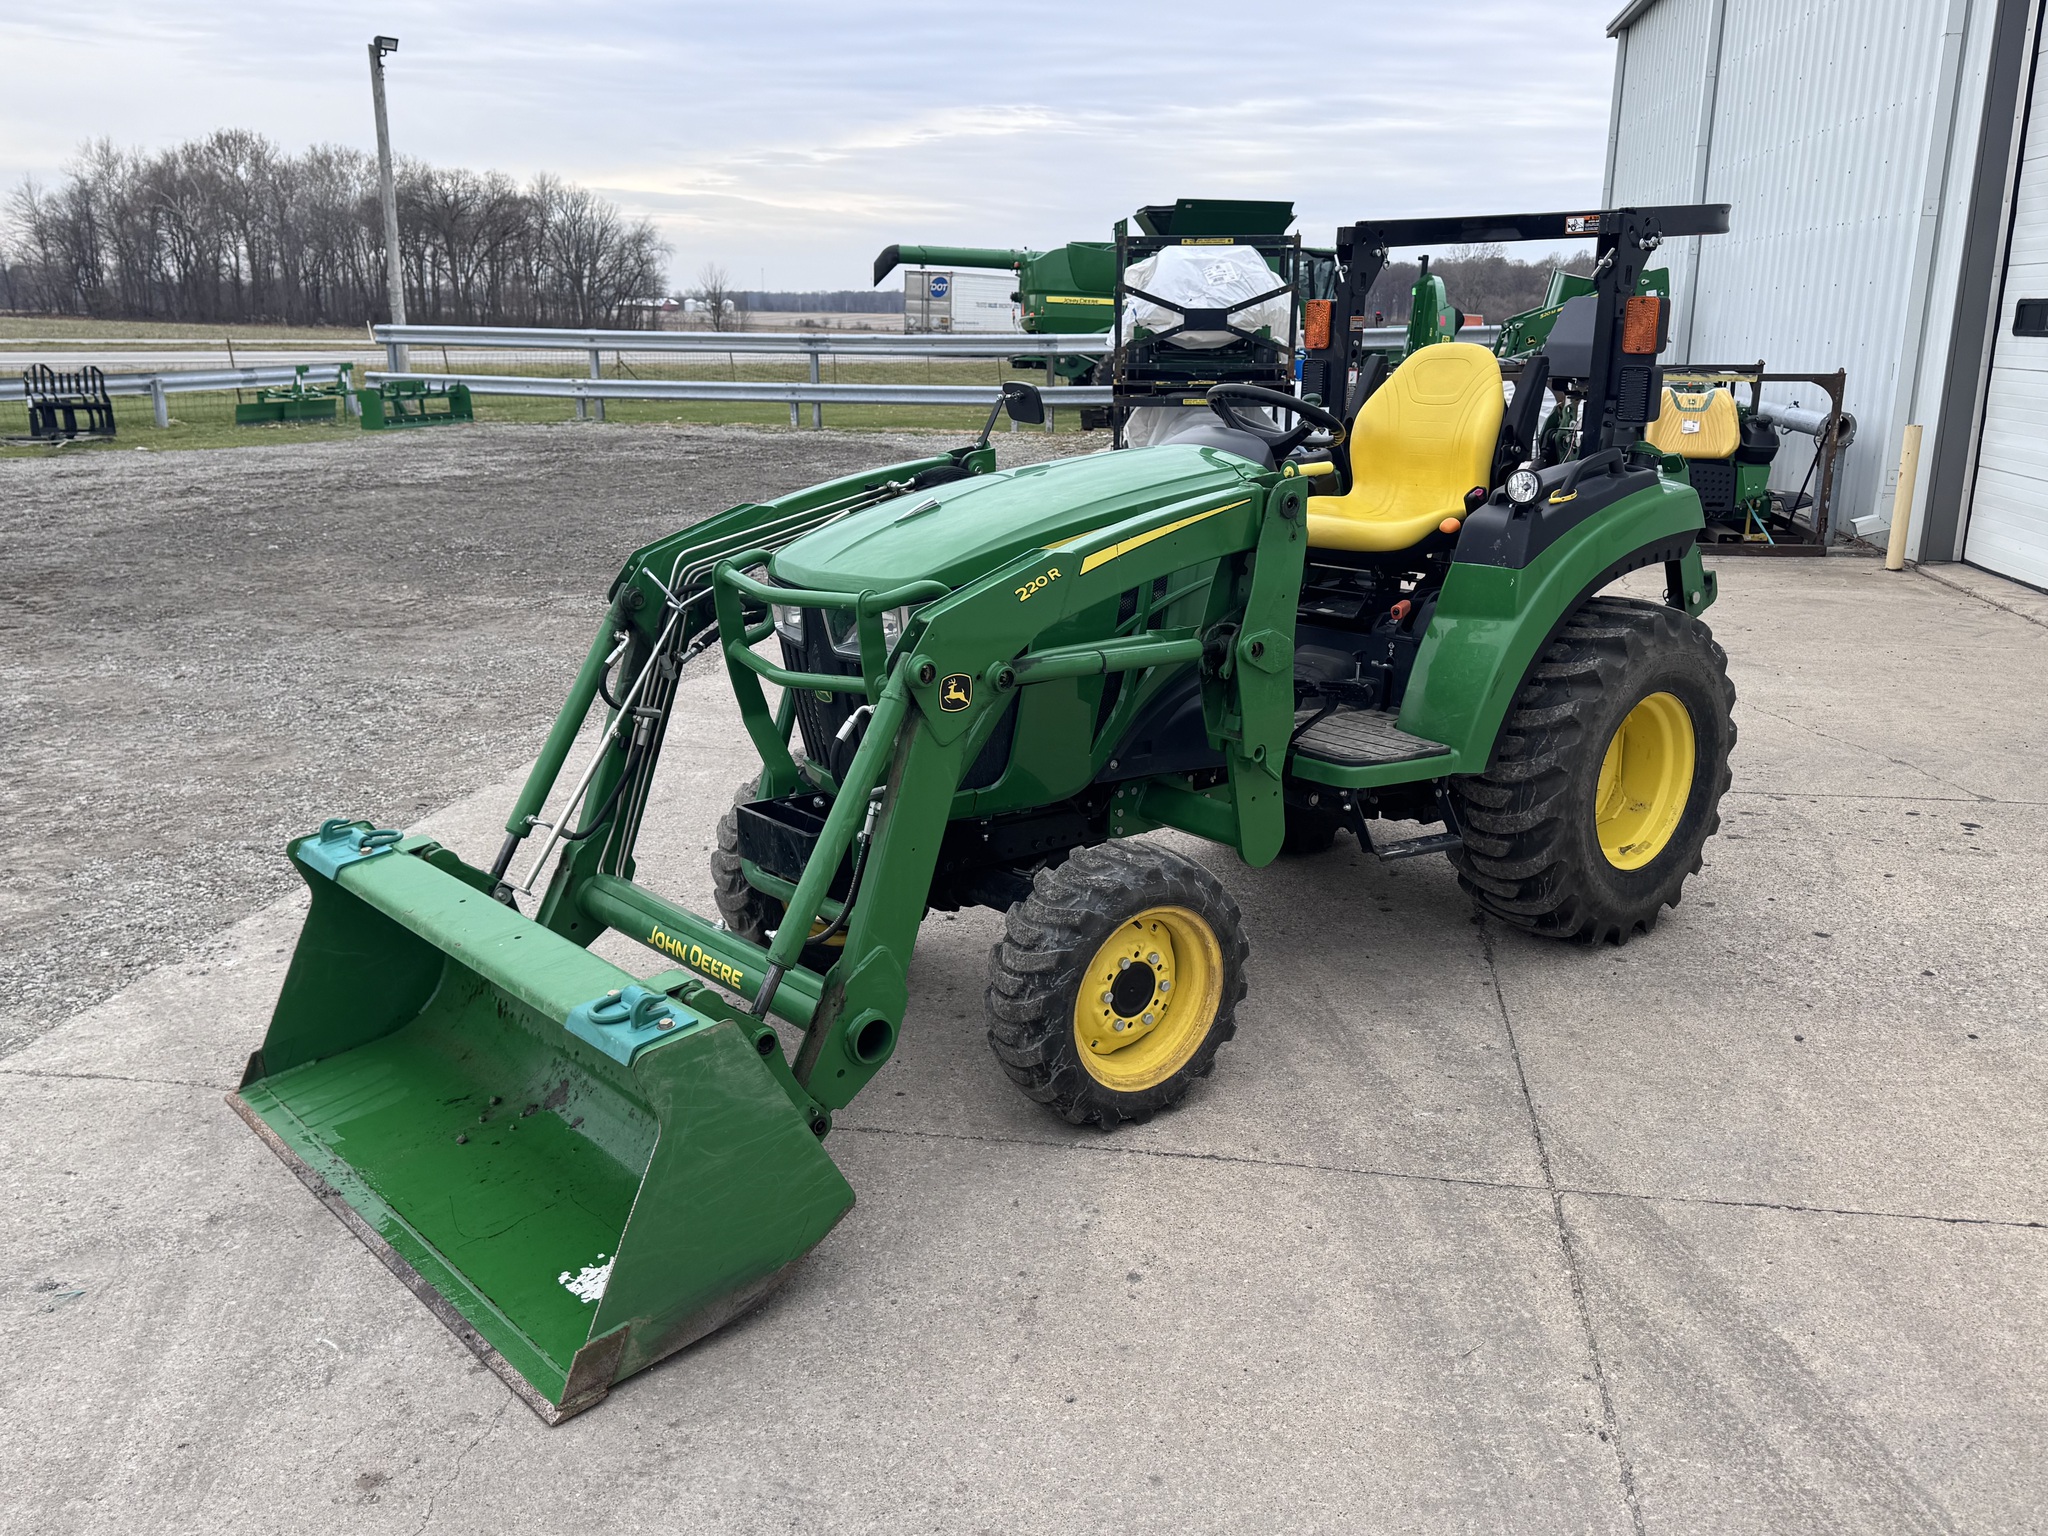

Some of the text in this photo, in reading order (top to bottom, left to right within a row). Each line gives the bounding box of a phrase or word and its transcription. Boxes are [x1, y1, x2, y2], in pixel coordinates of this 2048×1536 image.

[930, 283, 948, 291] DOT
[1079, 297, 1099, 305] DEERE
[646, 925, 744, 990] JOHN DEERE
